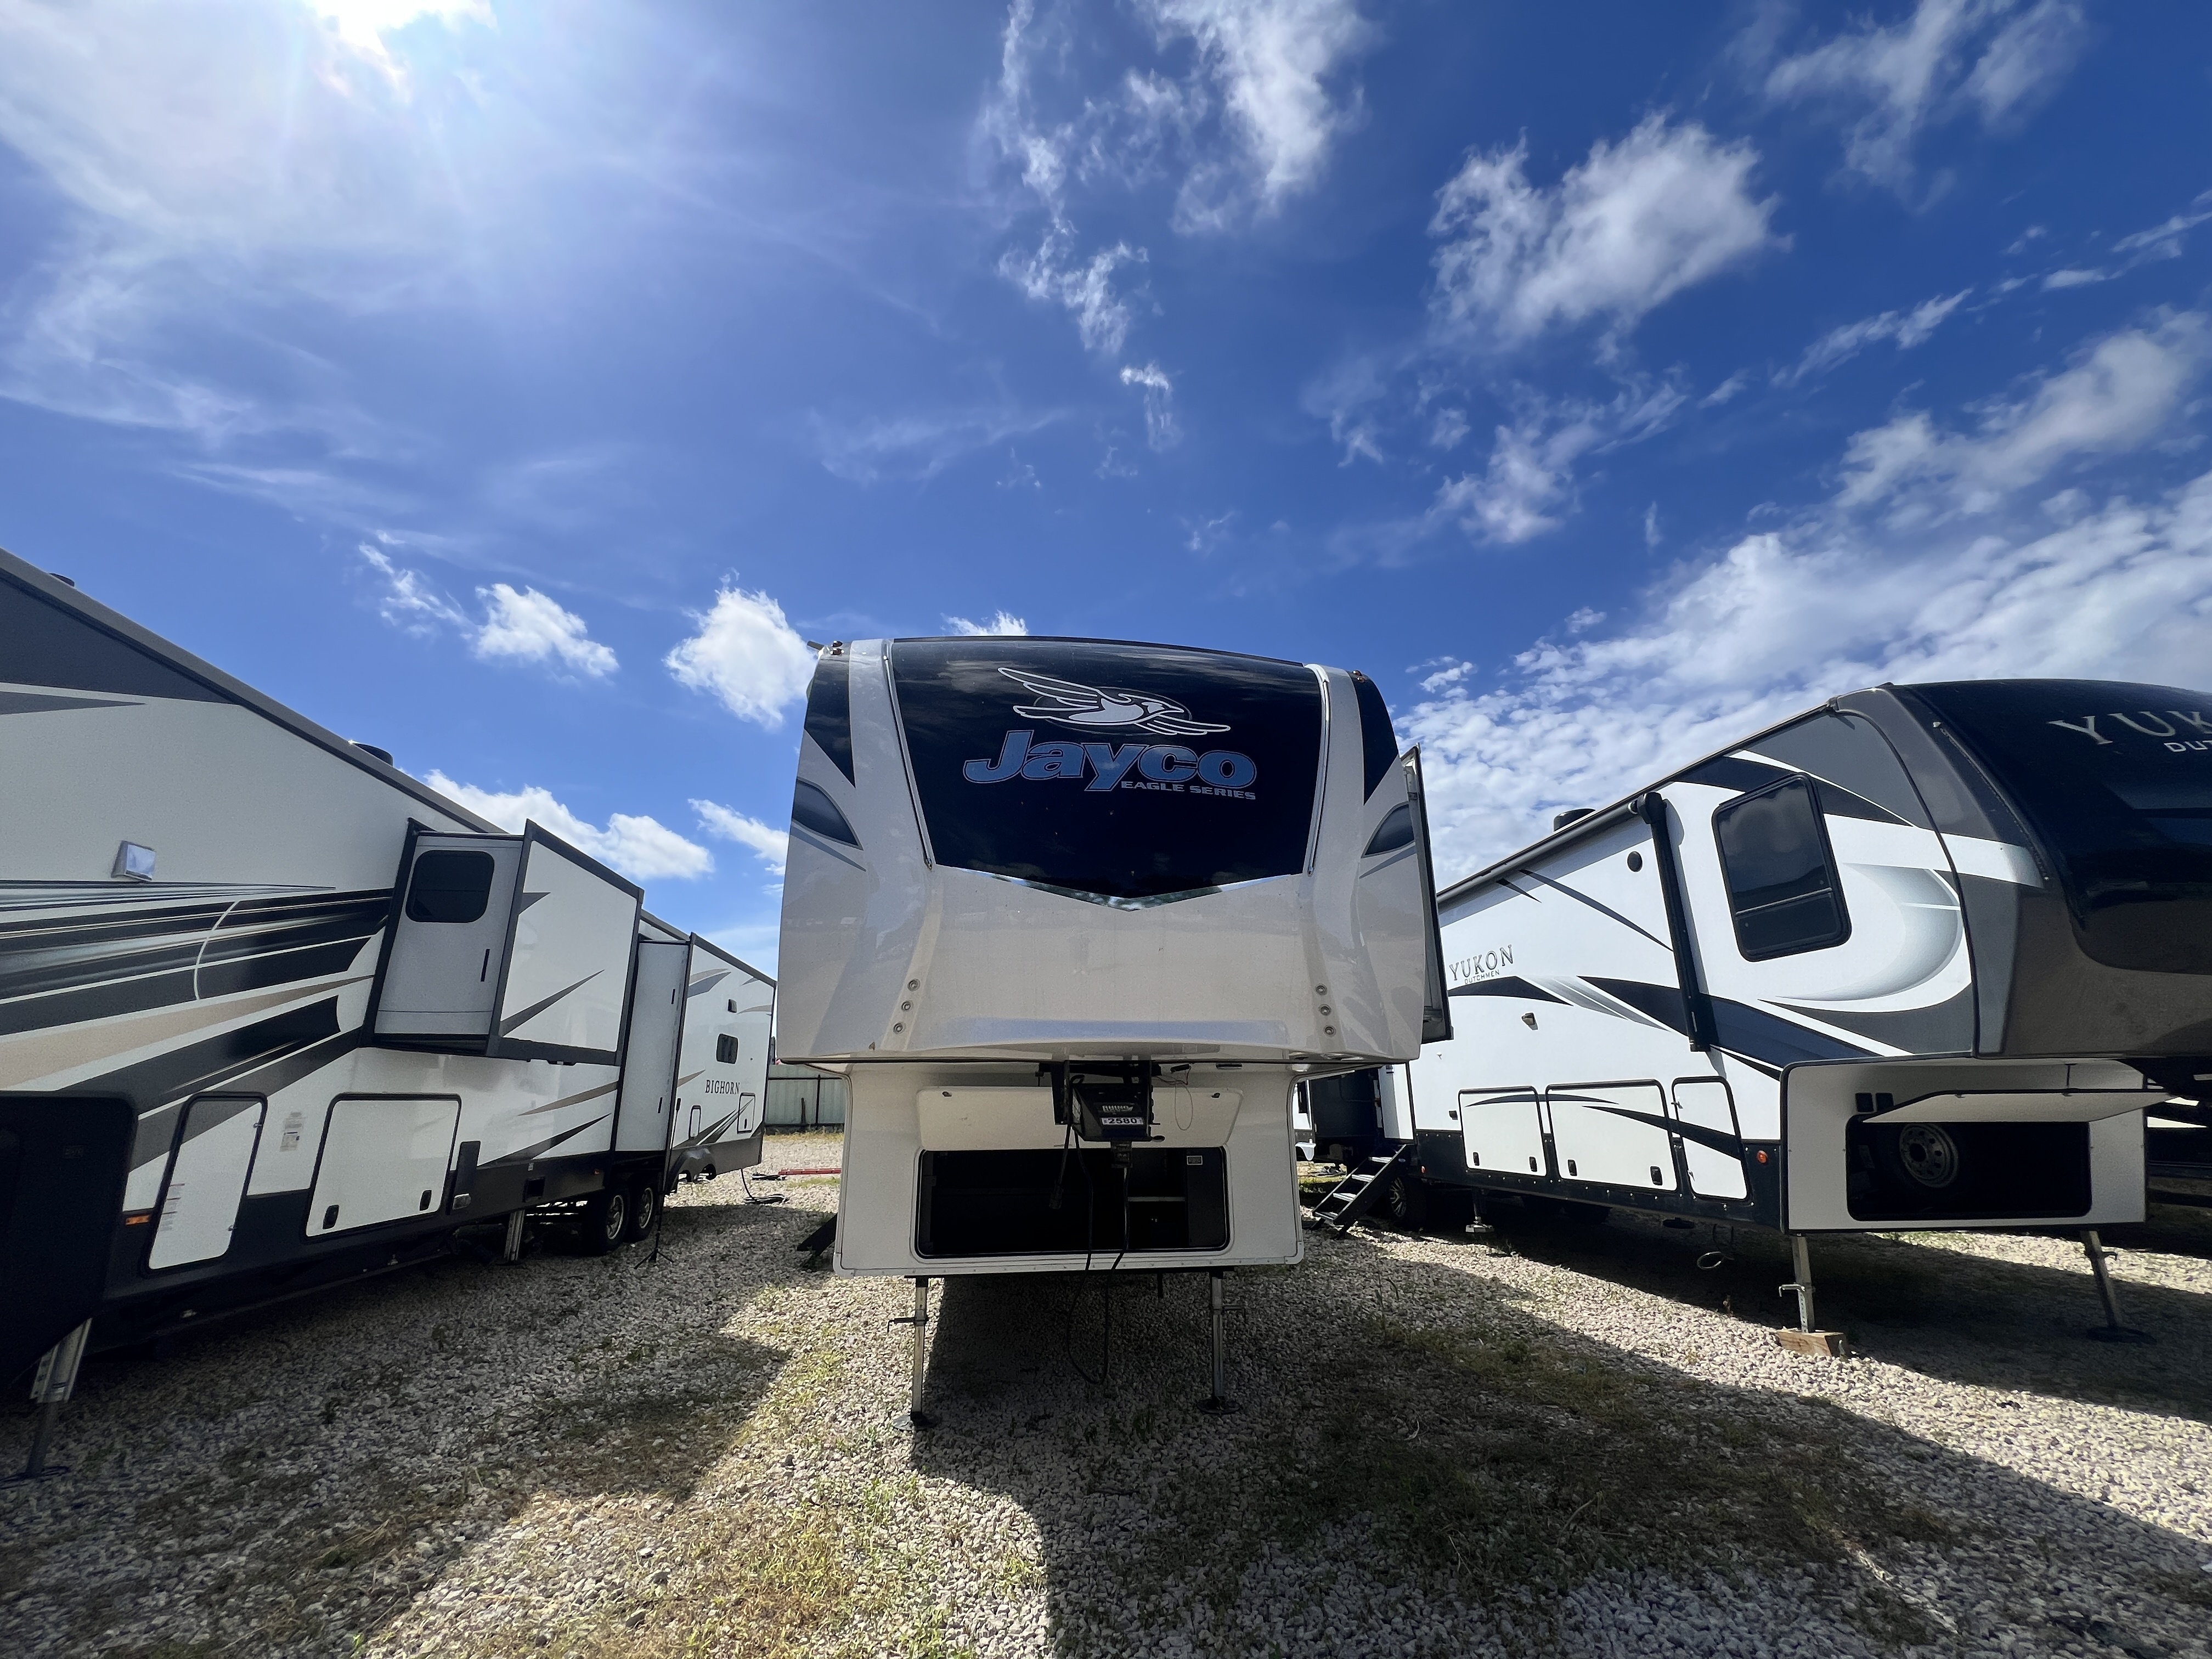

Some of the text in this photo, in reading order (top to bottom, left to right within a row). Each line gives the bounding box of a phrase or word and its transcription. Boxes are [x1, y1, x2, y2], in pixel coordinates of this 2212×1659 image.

[963, 730, 1256, 792] Jayco
[1121, 781, 1256, 800] EAGLE SERIES
[1449, 944, 1514, 981] YUKON
[1464, 969, 1500, 985] DUTCHMEN
[705, 1079, 740, 1094] BIGHORN
